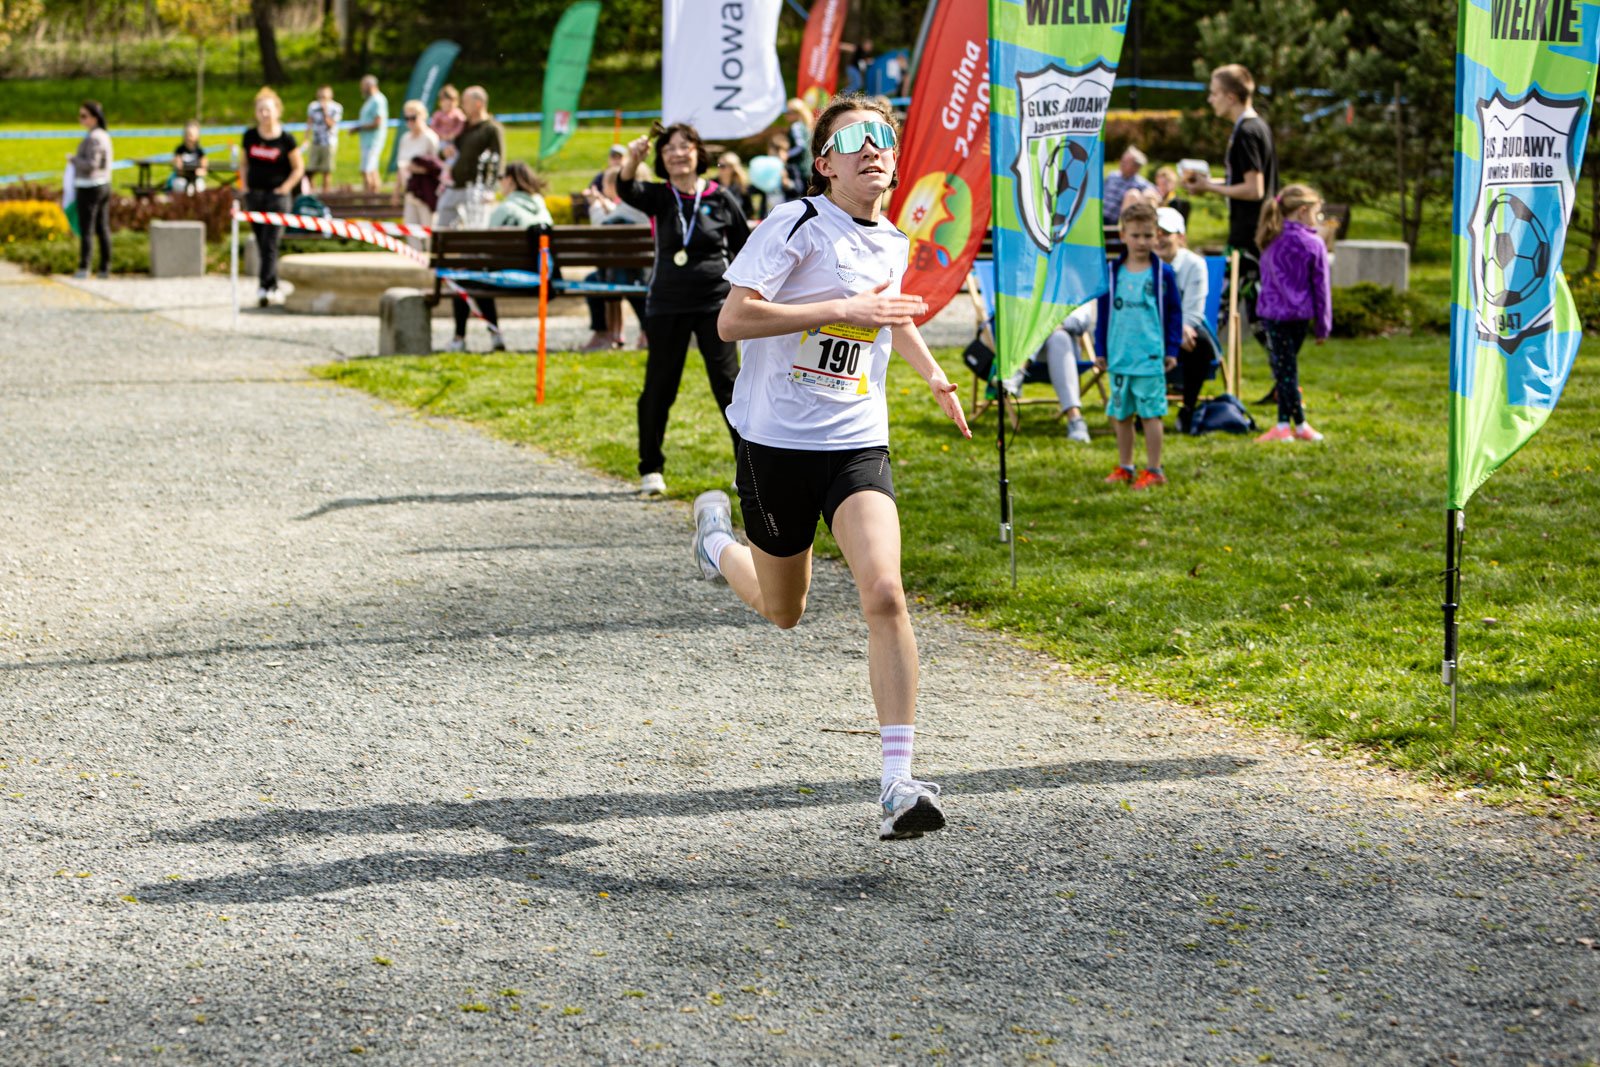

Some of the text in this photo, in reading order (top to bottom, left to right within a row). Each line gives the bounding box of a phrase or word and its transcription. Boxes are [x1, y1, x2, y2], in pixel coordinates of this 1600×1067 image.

[1026, 0, 1127, 26] WIELKIE
[1491, 0, 1579, 42] WIELKIE
[713, 2, 744, 111] Nowa
[941, 39, 982, 131] Gmina
[1028, 100, 1060, 118] GLKS
[1511, 162, 1553, 179] Wielkie
[1492, 312, 1521, 332] 1947
[817, 338, 861, 376] 190
